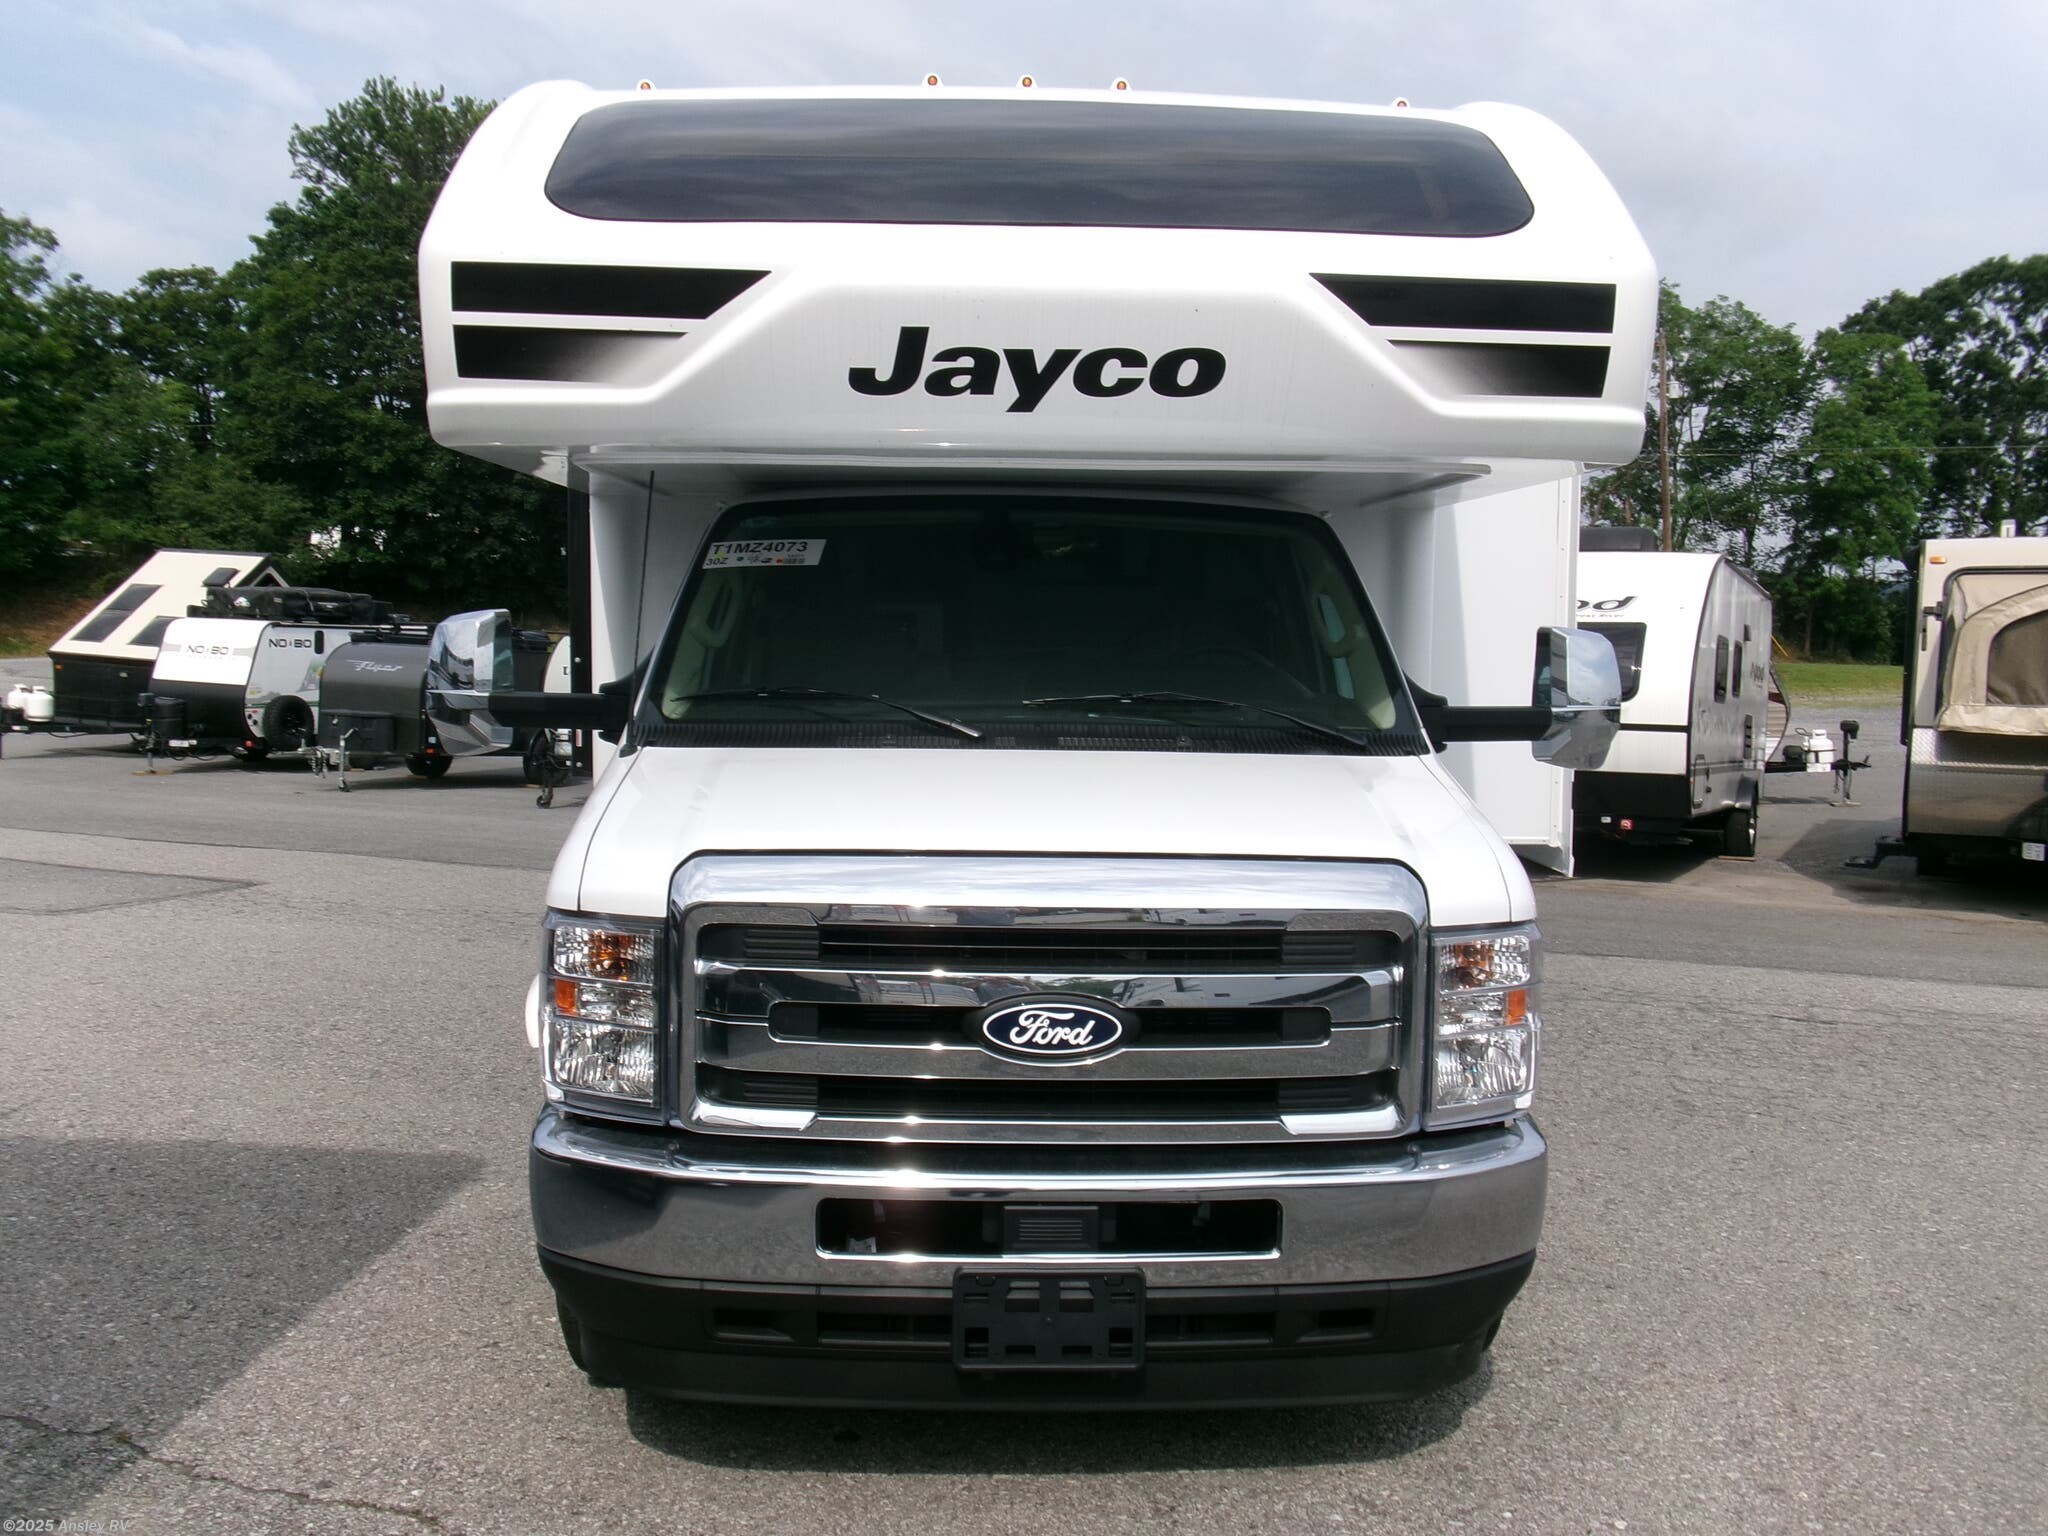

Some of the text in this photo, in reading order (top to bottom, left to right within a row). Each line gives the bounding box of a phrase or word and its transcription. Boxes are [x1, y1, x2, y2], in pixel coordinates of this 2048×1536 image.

[848, 326, 1227, 413] Jayco
[711, 541, 808, 555] T1MZ4073
[1009, 1010, 1096, 1046] Ford
